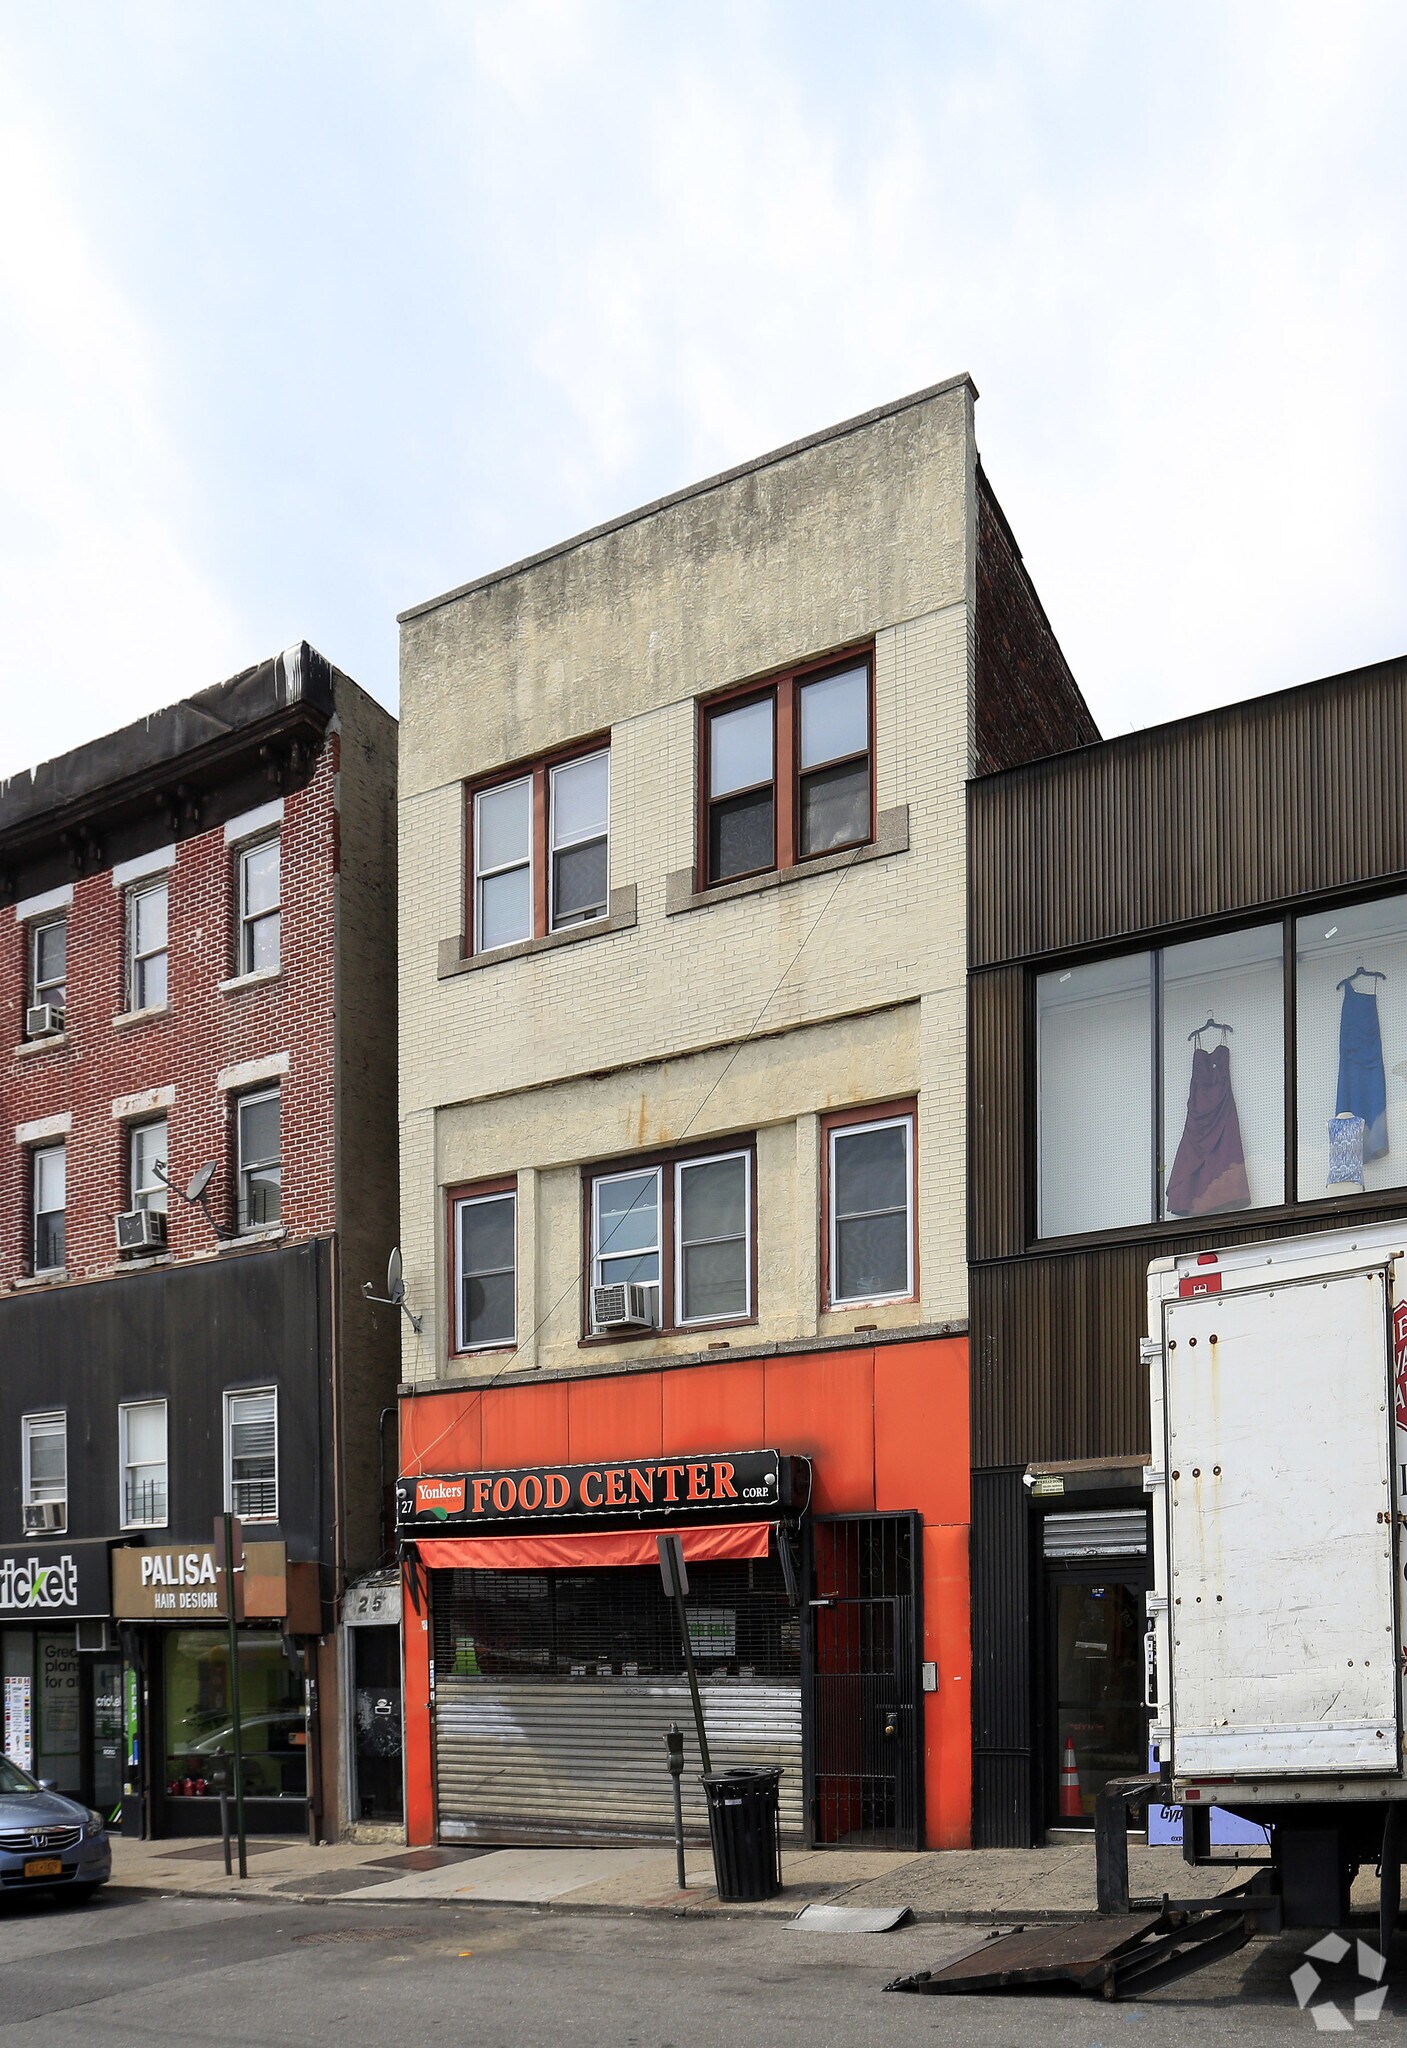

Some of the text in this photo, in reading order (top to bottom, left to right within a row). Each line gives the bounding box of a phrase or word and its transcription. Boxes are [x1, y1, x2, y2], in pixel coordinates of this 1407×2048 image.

[401, 1461, 769, 1514] 27 Yonkers FOOD CENTER CORP.
[141, 1552, 245, 1586] PALISA
[154, 1591, 218, 1609] HAIR DESIGNE
[358, 1595, 383, 1614] 25
[45, 1675, 63, 1688] for
